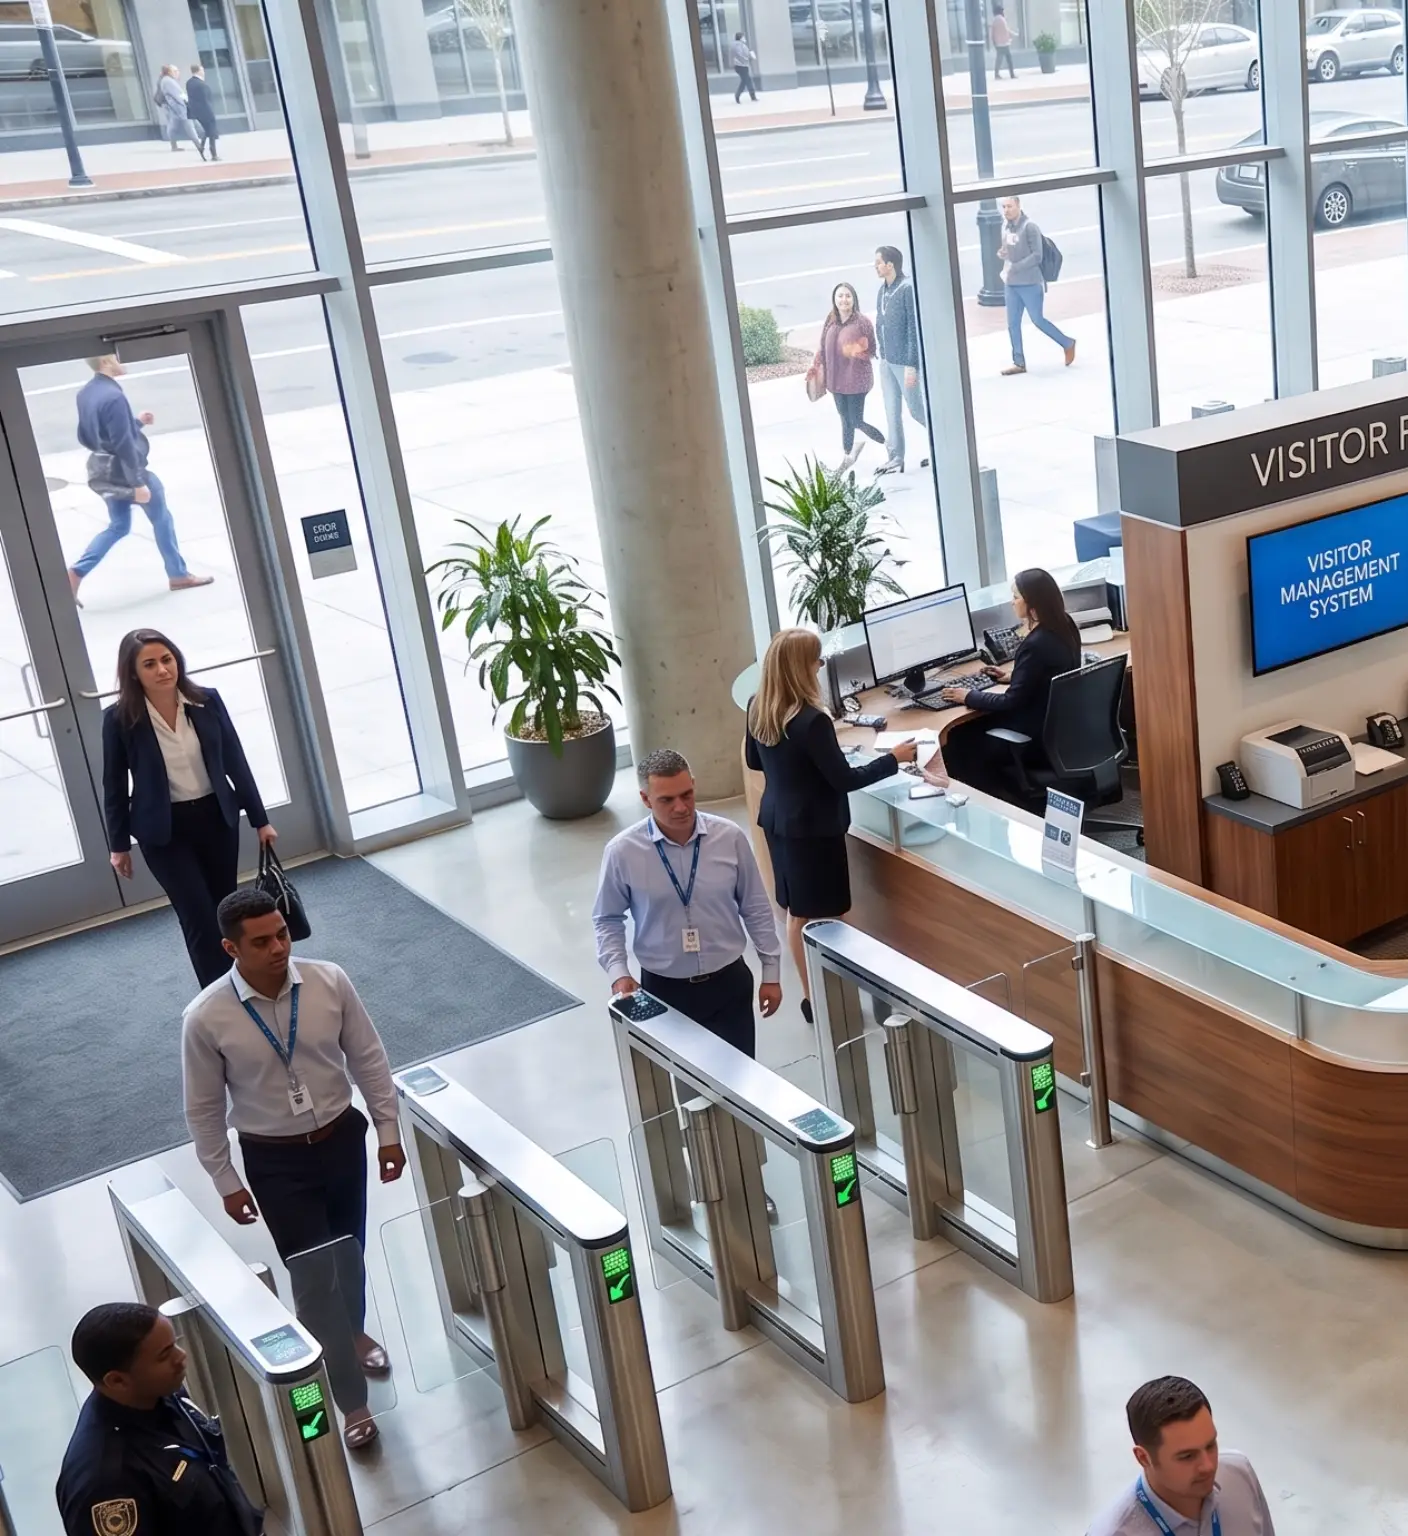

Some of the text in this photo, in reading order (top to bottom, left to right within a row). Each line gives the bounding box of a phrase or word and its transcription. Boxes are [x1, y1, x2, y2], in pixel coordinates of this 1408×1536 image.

[1251, 421, 1389, 487] VISITOR
[1307, 539, 1372, 573] VISITOR
[1280, 552, 1400, 605] MANAGEMENT
[1309, 583, 1373, 619] SYSTEM
